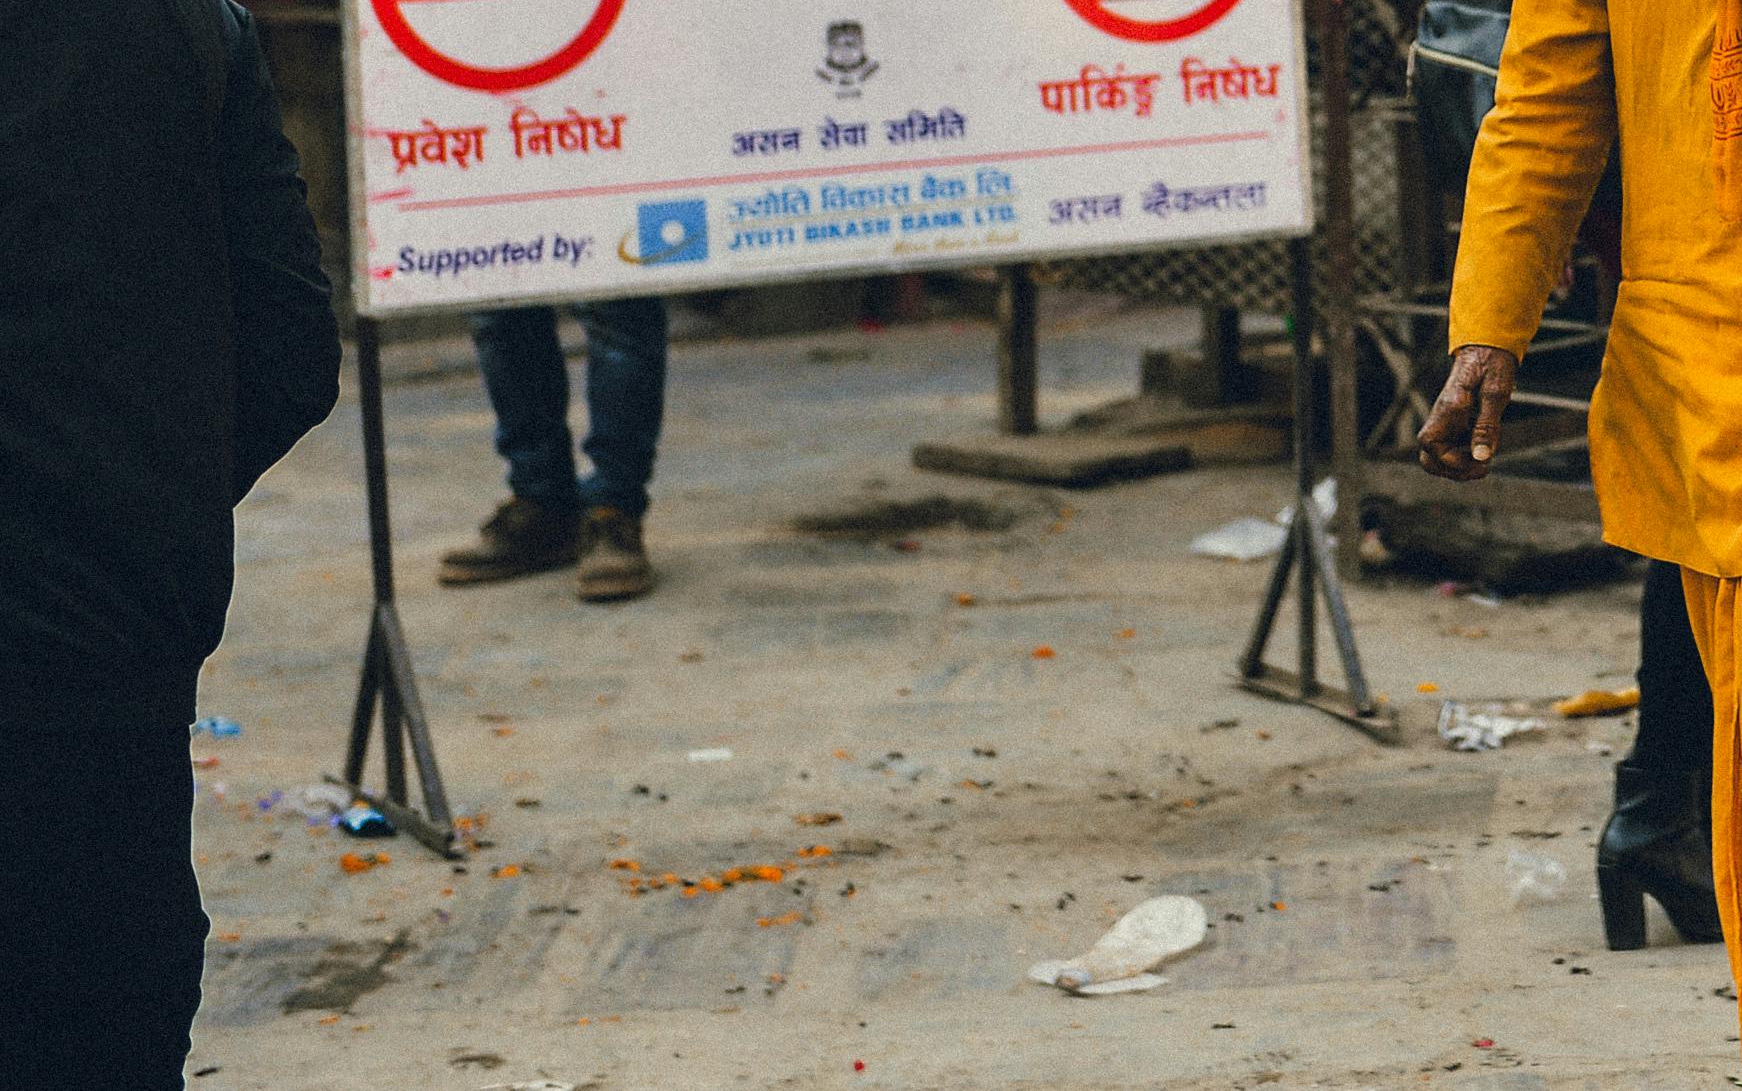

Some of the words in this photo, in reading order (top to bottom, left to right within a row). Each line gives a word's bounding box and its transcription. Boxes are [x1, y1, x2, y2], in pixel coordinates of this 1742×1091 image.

[1180, 56, 1282, 105] निषेध
[386, 117, 488, 174] प्रवेश
[509, 106, 627, 158] निषेध
[817, 114, 867, 150] सेवा
[883, 105, 967, 144] समिति
[805, 218, 891, 243] BIKASH
[901, 210, 964, 233] BANK
[1049, 194, 1121, 225] असन
[399, 234, 545, 277] Supported
[553, 232, 594, 267] by:
